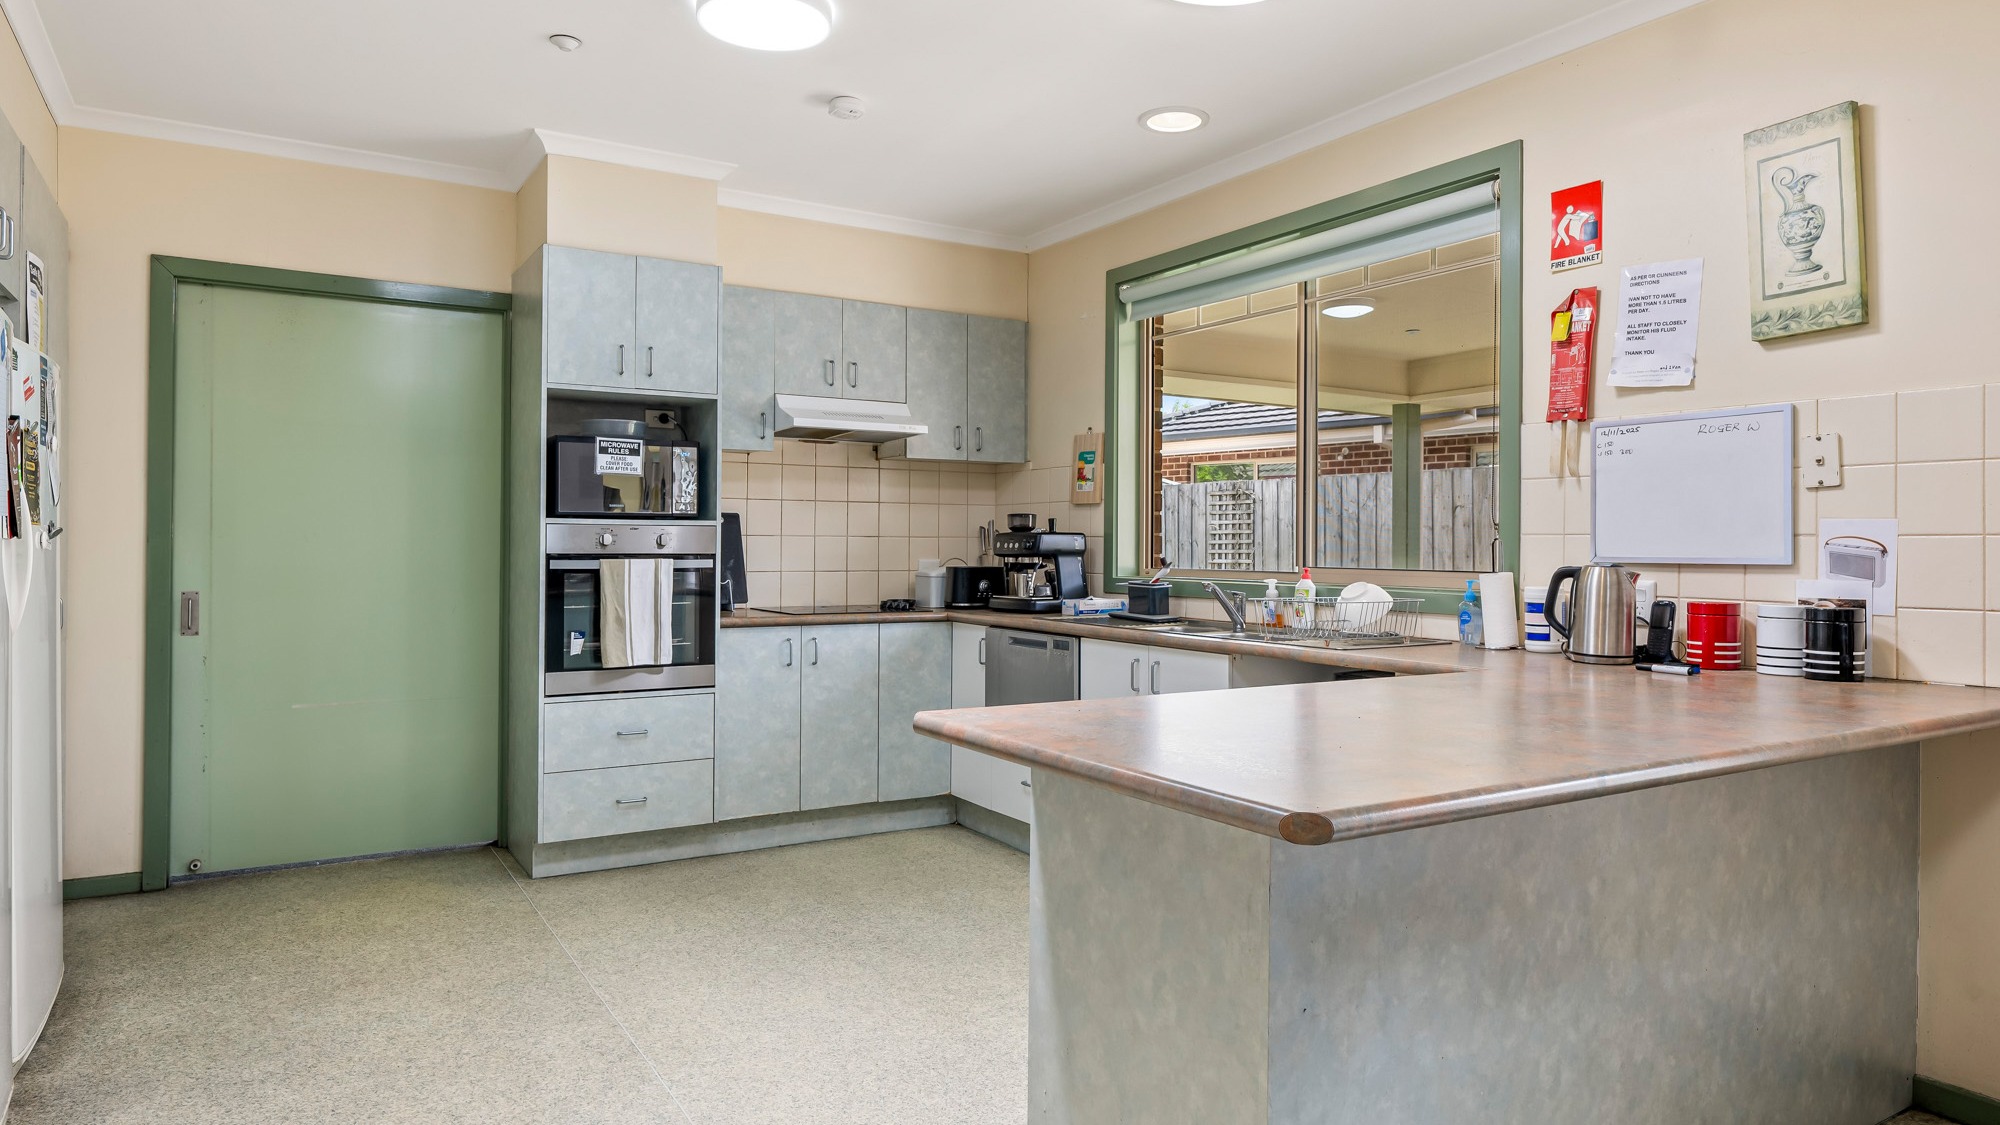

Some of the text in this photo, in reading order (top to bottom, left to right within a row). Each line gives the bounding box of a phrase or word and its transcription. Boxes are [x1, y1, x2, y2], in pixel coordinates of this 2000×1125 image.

[1550, 252, 1601, 269] FIRE BLANKET
[1626, 328, 1650, 336] MONITOR
[1697, 421, 1761, 435] ROGER W
[600, 441, 639, 449] MICROWAVE
